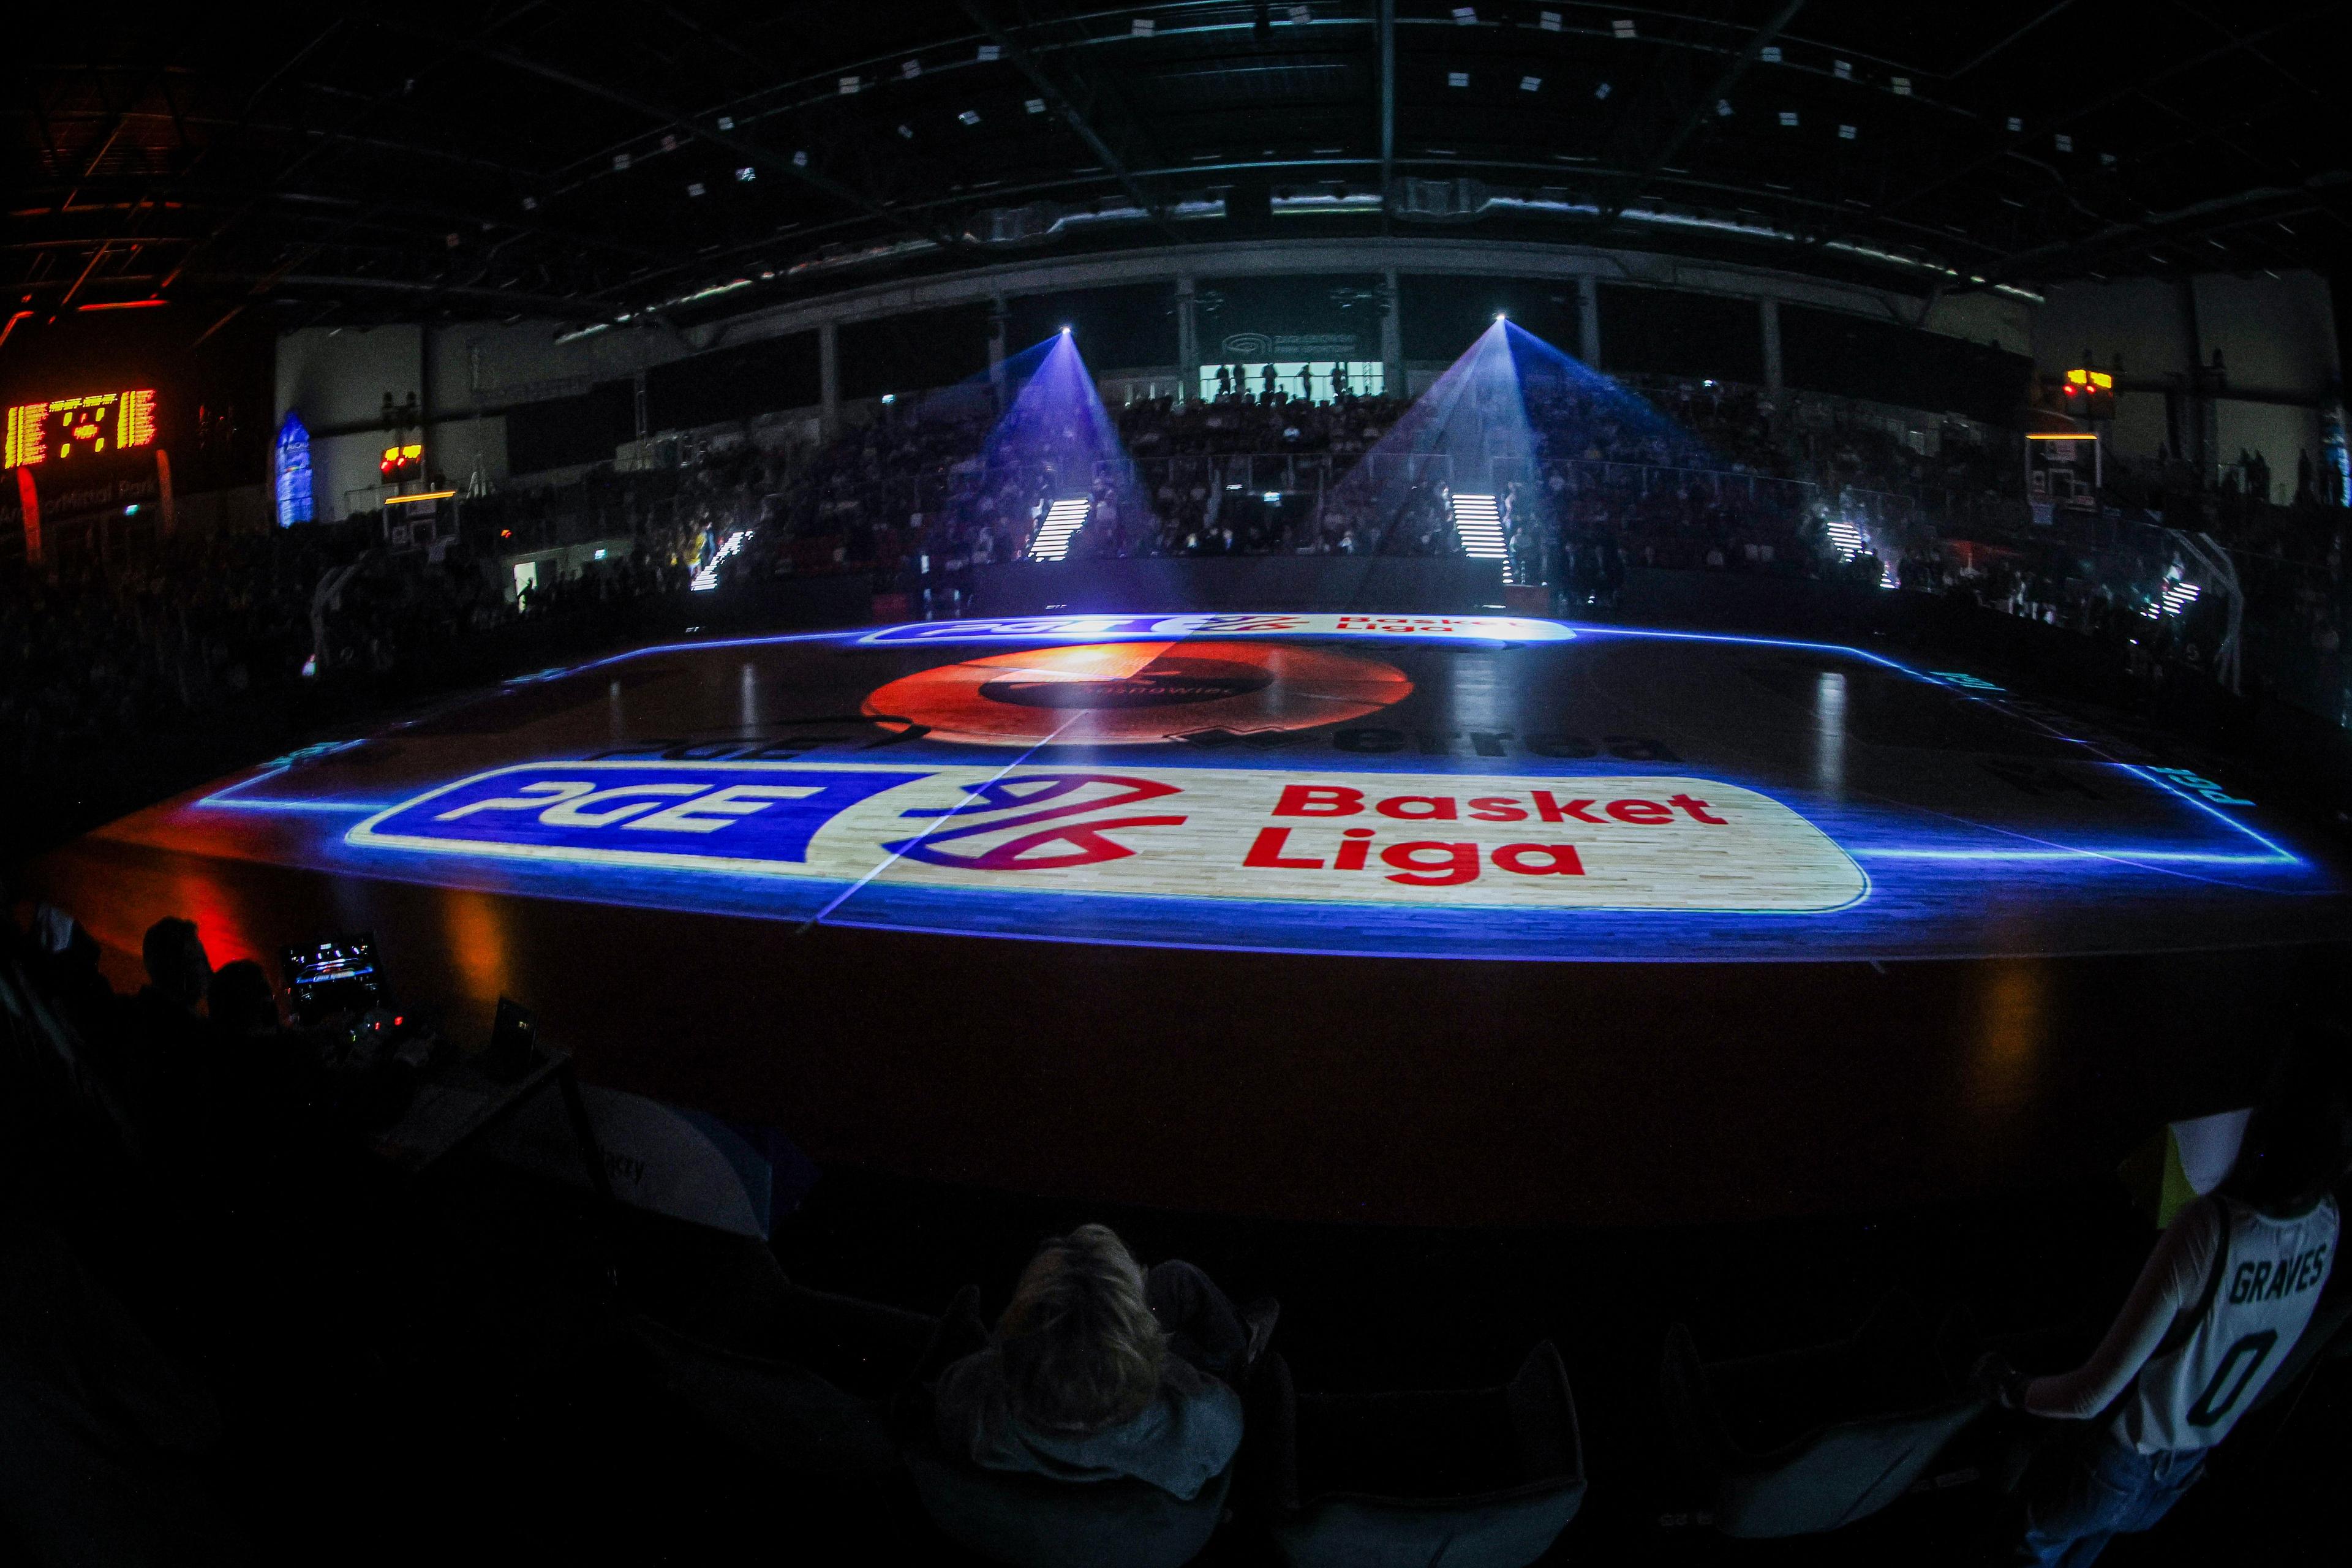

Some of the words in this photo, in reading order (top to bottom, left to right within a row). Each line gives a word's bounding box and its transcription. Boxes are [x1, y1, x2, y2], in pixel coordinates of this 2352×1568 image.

[1336, 623, 1452, 631] Liga
[1340, 616, 1525, 626] Basket
[432, 780, 828, 834] PGE
[1272, 785, 1728, 825] Basket
[1243, 827, 1585, 886] Liga
[2230, 1242, 2327, 1305] GRAVES
[2187, 1329, 2278, 1427] 0
